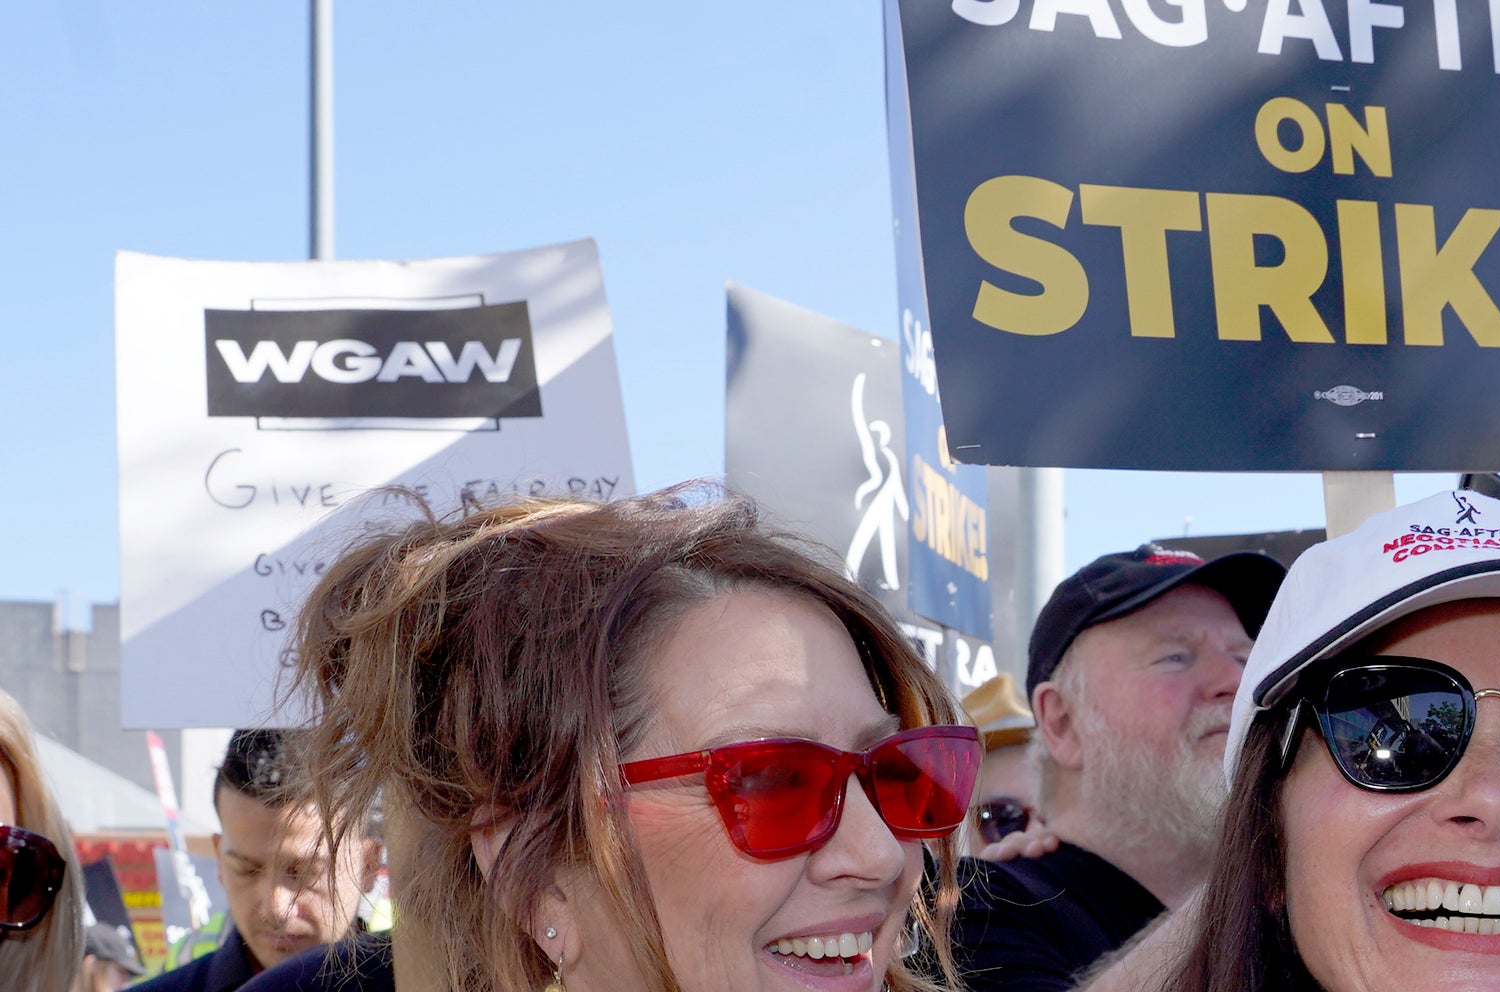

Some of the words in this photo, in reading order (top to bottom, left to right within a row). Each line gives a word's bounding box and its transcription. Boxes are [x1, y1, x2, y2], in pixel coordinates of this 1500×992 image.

[1254, 97, 1393, 178] ON
[215, 338, 522, 383] WGAW
[205, 448, 340, 508] GIVE
[567, 476, 620, 500] PAY
[913, 453, 989, 582] STRIKE!
